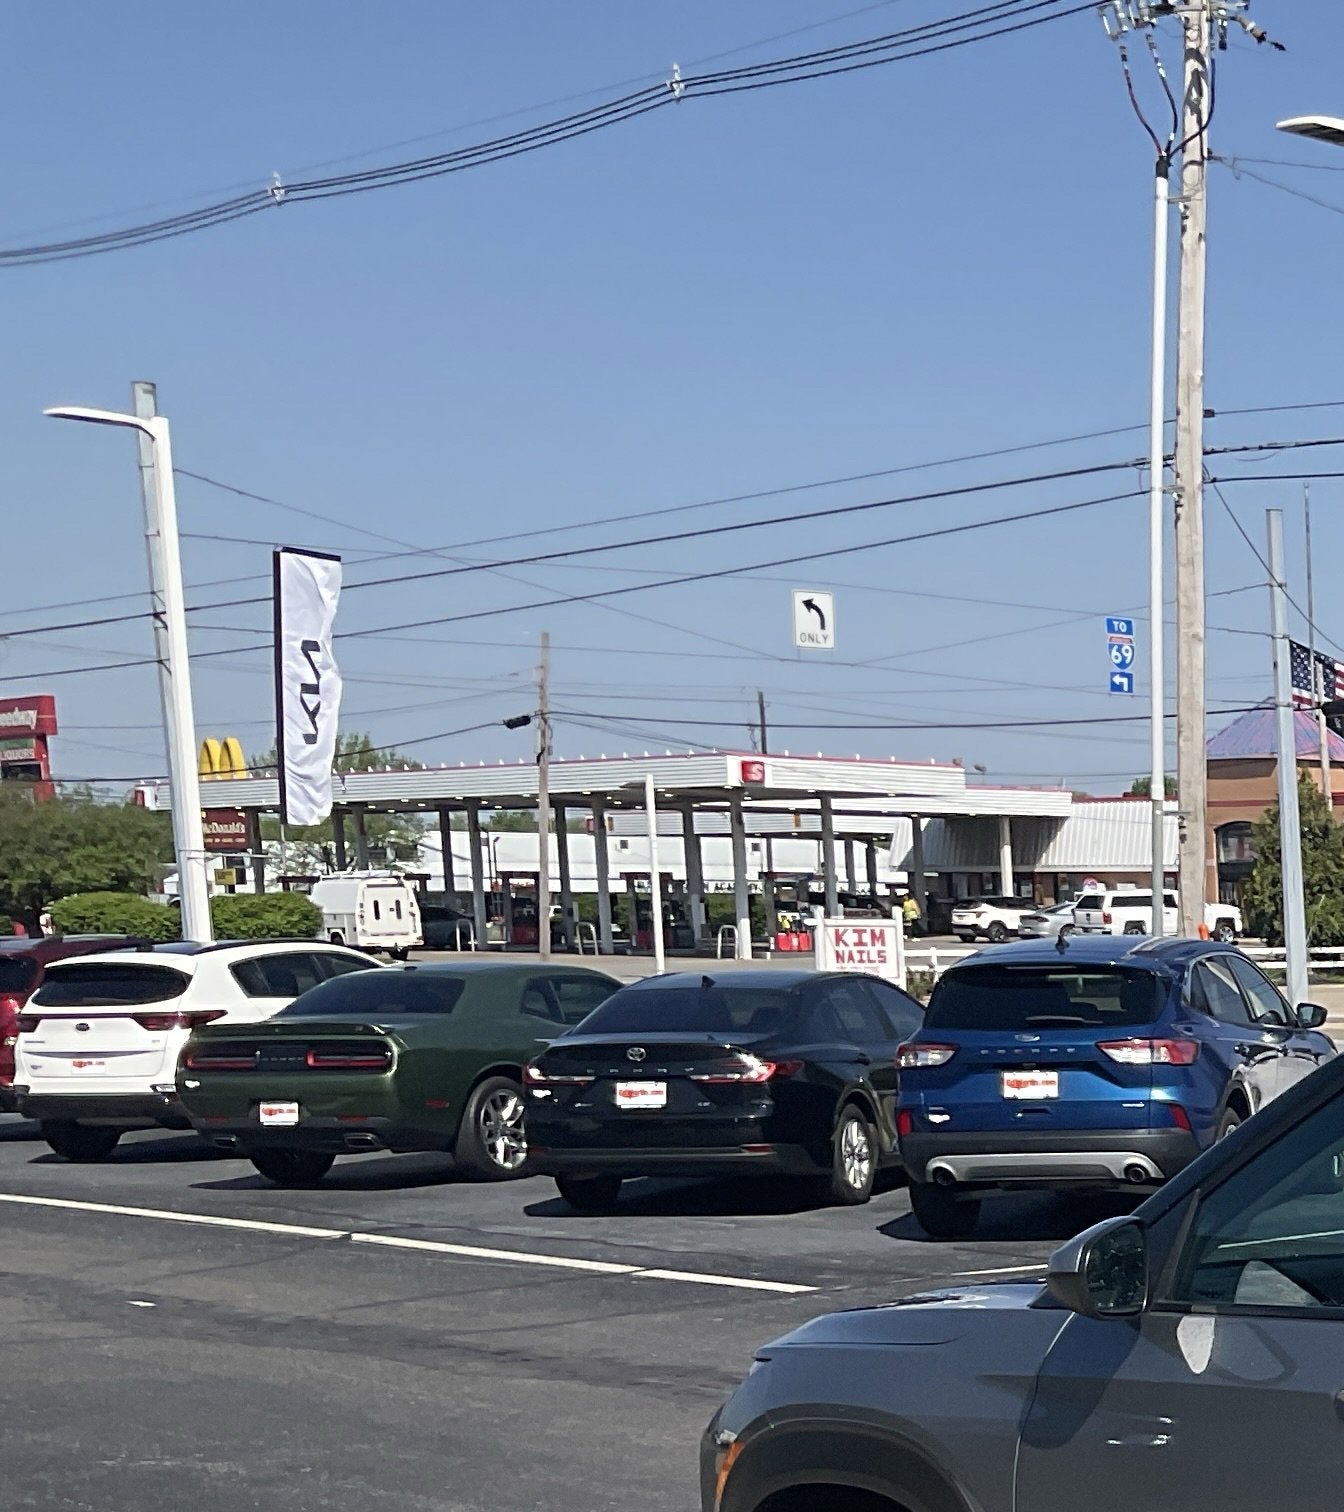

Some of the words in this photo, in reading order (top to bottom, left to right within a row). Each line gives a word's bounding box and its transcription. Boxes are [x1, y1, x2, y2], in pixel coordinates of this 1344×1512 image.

[1112, 620, 1128, 633] TO
[799, 632, 829, 645] ONLY
[1110, 644, 1133, 664] 69
[834, 928, 887, 947] KIM
[835, 949, 888, 964] NAILS
